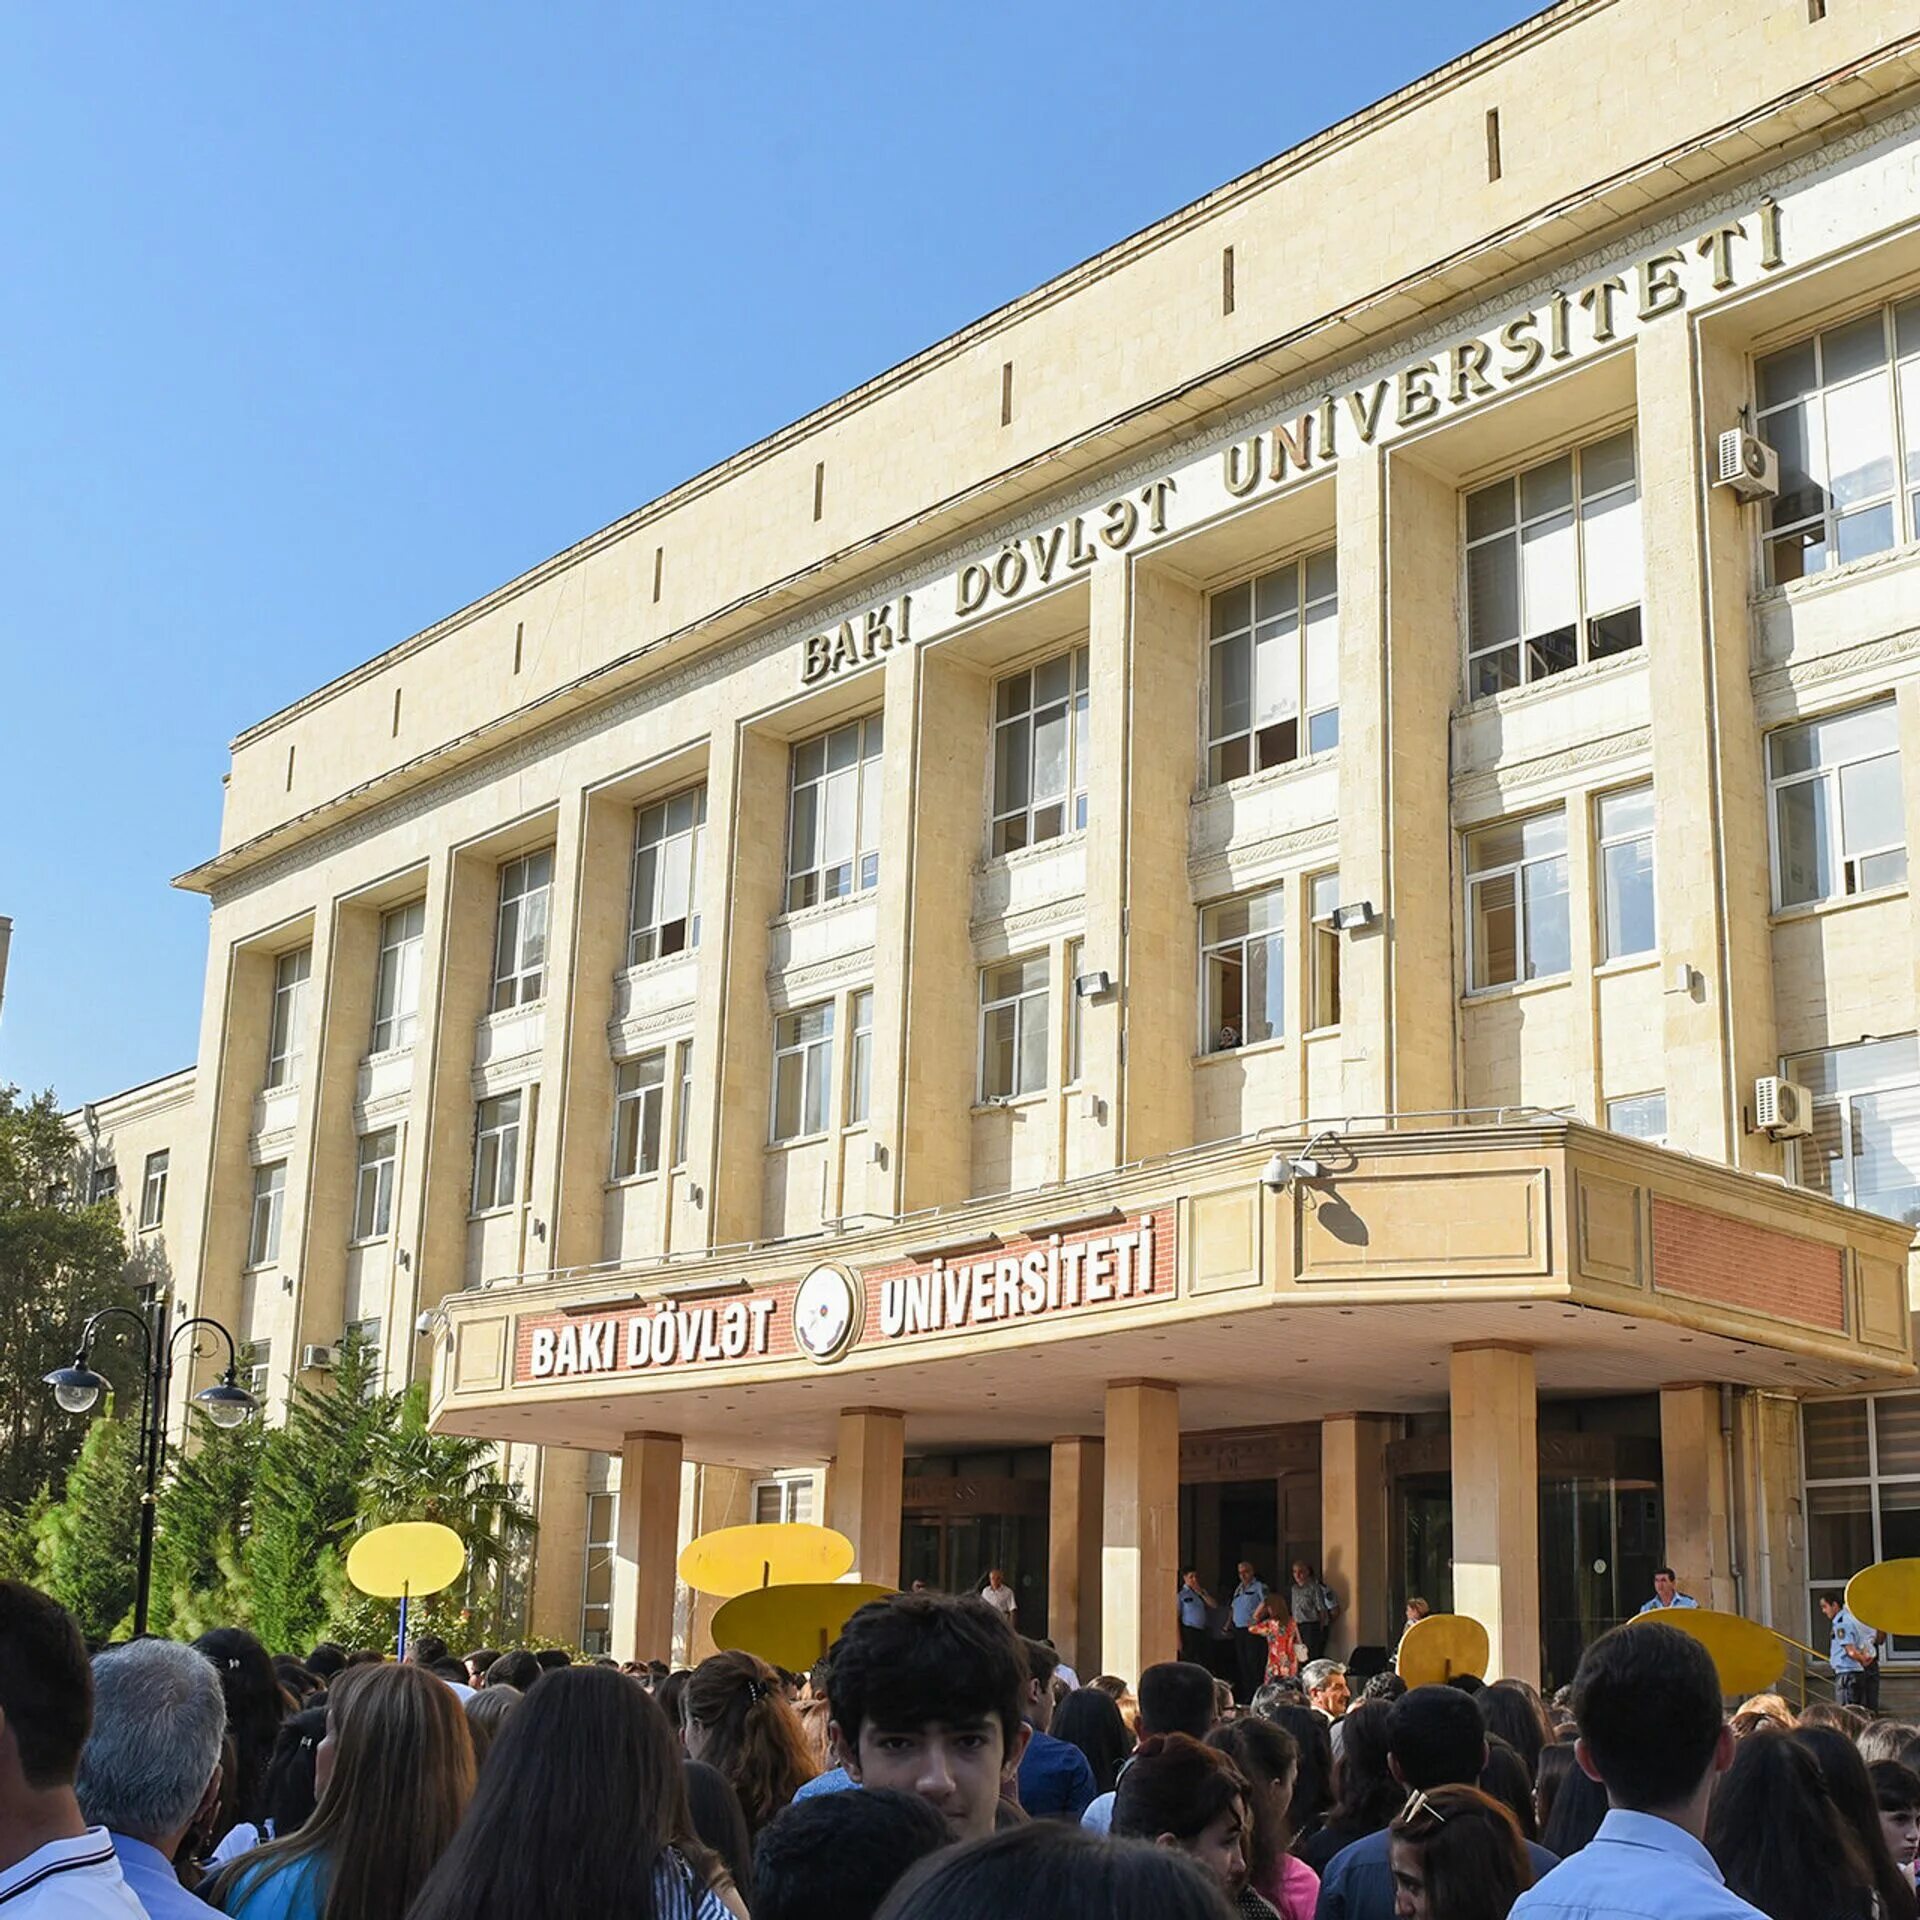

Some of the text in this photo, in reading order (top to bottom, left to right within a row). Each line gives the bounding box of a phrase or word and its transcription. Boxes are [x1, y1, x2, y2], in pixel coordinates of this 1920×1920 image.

[802, 196, 1782, 684] BAKI DÖVLƏT UNİVERSİTETİ
[531, 1321, 617, 1377] BAKI
[628, 1300, 776, 1368] DÖVLƏT
[880, 1215, 1155, 1336] UNİVERSİTETİ
